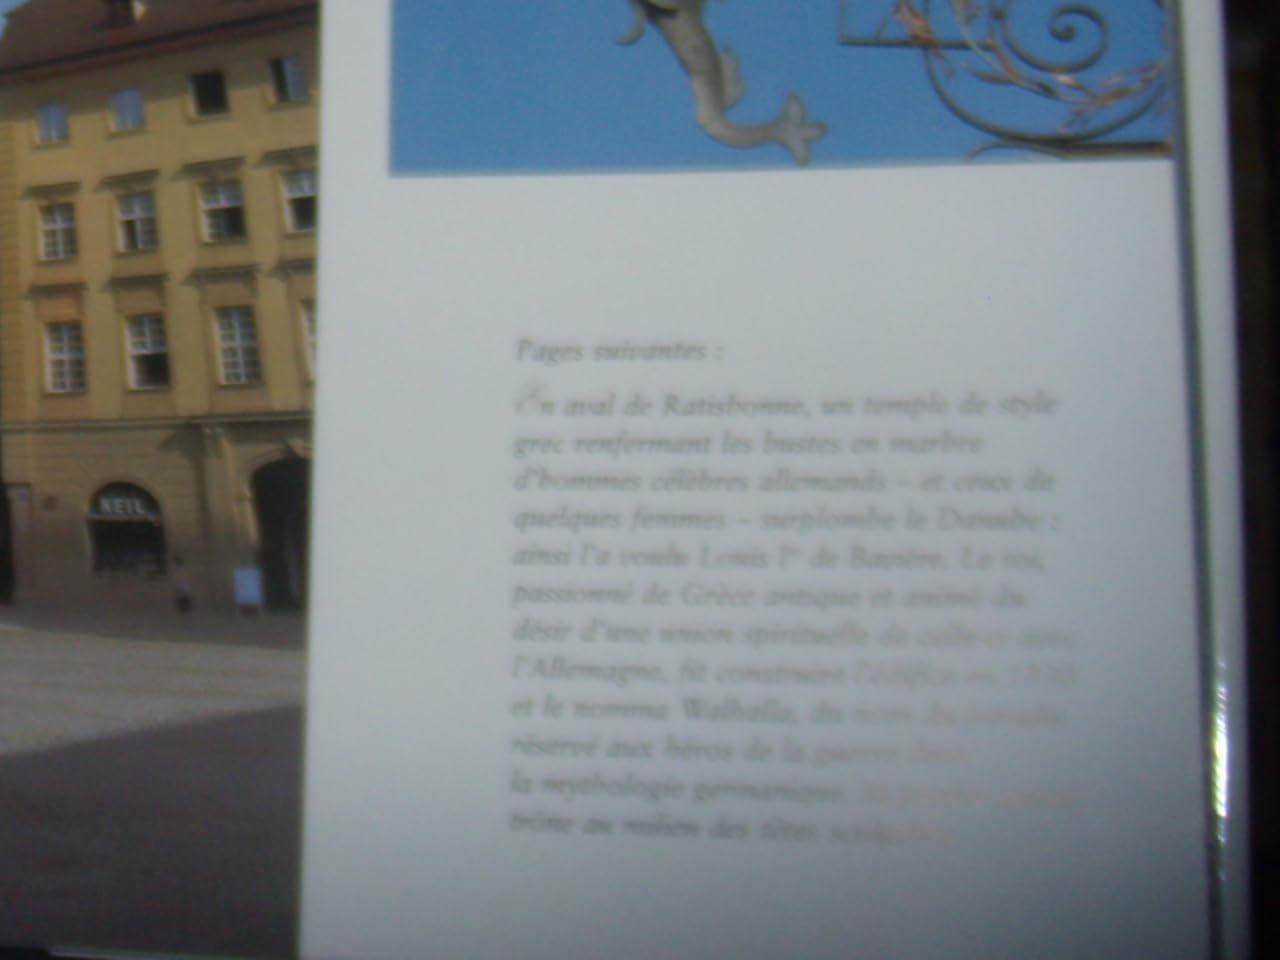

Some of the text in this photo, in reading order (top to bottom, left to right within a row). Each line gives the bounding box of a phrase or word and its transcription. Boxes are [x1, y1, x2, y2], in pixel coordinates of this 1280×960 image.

[514, 337, 585, 367] Pages
[592, 340, 708, 363] suivantes
[562, 392, 617, 418] aval
[622, 392, 654, 418] de
[820, 399, 855, 418] un
[862, 390, 949, 423] temple
[956, 390, 989, 418] de
[575, 429, 711, 460] renfermant
[722, 428, 753, 456] les
[762, 428, 842, 456] bustes
[887, 429, 985, 456] marbre
[512, 504, 622, 534] quelques
